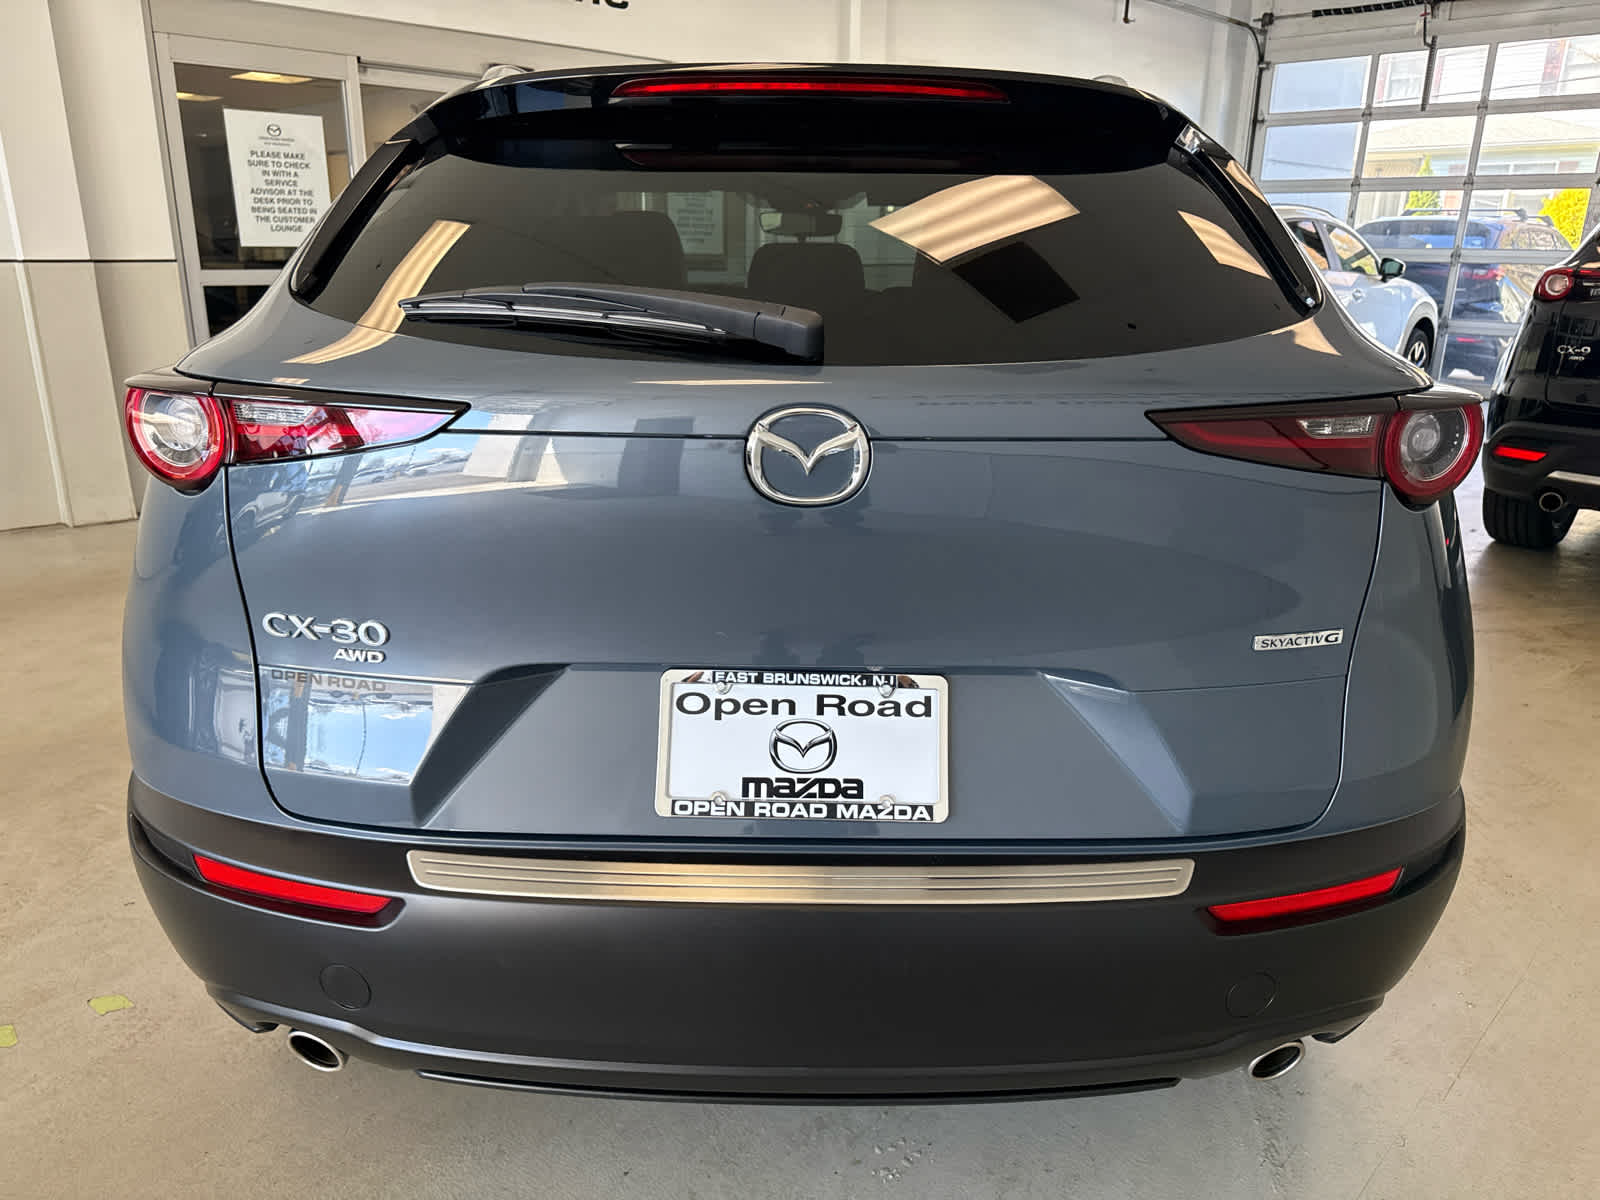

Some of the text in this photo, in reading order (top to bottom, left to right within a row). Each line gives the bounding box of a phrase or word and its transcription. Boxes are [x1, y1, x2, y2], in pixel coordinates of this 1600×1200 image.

[250, 150, 305, 160] PLEASE MAKE
[247, 159, 311, 169] SURE TO CHECK
[262, 169, 271, 177] IN
[272, 170, 292, 178] WITH
[264, 179, 298, 187] SERVICE
[250, 187, 313, 197] ADVISOR AT THE
[253, 197, 313, 206] DESK PRIOR TO
[251, 206, 276, 214] BEING
[277, 207, 308, 215] SEATED
[255, 215, 271, 224] THE
[1557, 344, 1591, 356] CX-9
[262, 612, 390, 647] CX-30
[333, 647, 386, 663] AWD
[271, 669, 386, 692] OPEN ROAD
[714, 671, 758, 684] EAST
[763, 672, 867, 687] BRUNSWICK,
[675, 691, 932, 721] Open Road
[673, 801, 931, 822] OPEN ROAD MAZDA
